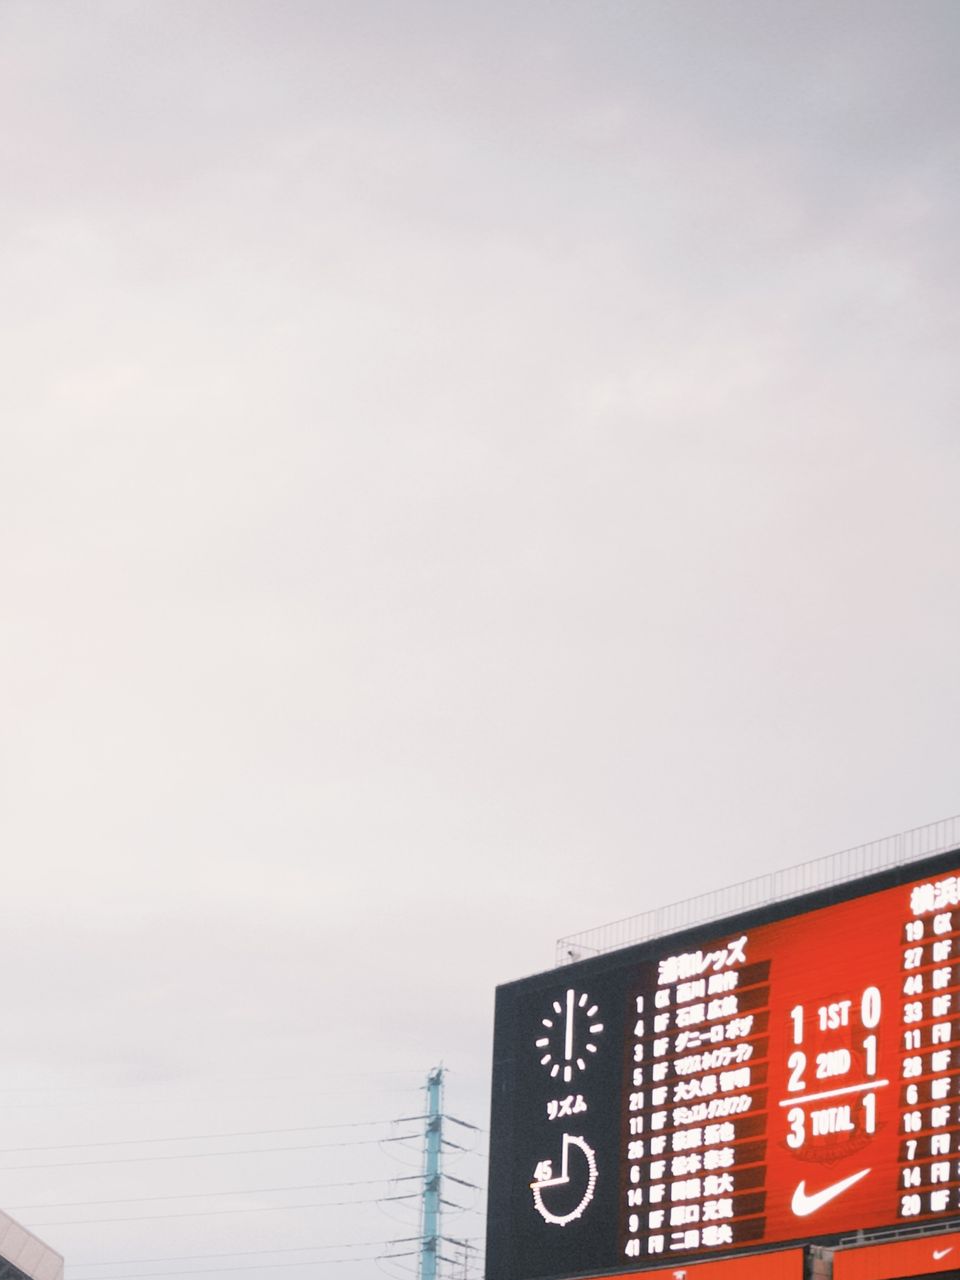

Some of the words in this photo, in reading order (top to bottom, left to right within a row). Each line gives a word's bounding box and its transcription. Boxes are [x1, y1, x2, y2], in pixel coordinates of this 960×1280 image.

[905, 920, 924, 942] 19
[904, 947, 923, 969] 27
[903, 974, 923, 995] 44
[636, 996, 644, 1013] 1
[791, 1005, 803, 1044] 1
[818, 1000, 851, 1031] 1ST
[861, 986, 881, 1028] 0
[903, 1001, 923, 1024] 33
[634, 1020, 644, 1037] 4
[904, 1029, 921, 1050] 11
[633, 1043, 644, 1062] 3
[787, 1051, 807, 1092] 2
[816, 1048, 851, 1079] 2ND
[863, 1035, 876, 1075] 1
[633, 1067, 643, 1086] 5
[629, 1091, 644, 1111] 21
[906, 1084, 918, 1105] 6
[547, 1094, 587, 1120] リズム
[629, 1116, 643, 1135] 11
[786, 1107, 805, 1148] 3
[810, 1105, 855, 1136] TOTAL
[862, 1093, 876, 1133] 1
[903, 1111, 922, 1132] 16
[906, 1140, 917, 1160] 7
[533, 1160, 555, 1184] 45
[630, 1165, 640, 1184] 6
[902, 1166, 921, 1188] 14
[627, 1188, 643, 1207] 14
[628, 1214, 639, 1233] 9
[624, 1238, 640, 1257] 41
